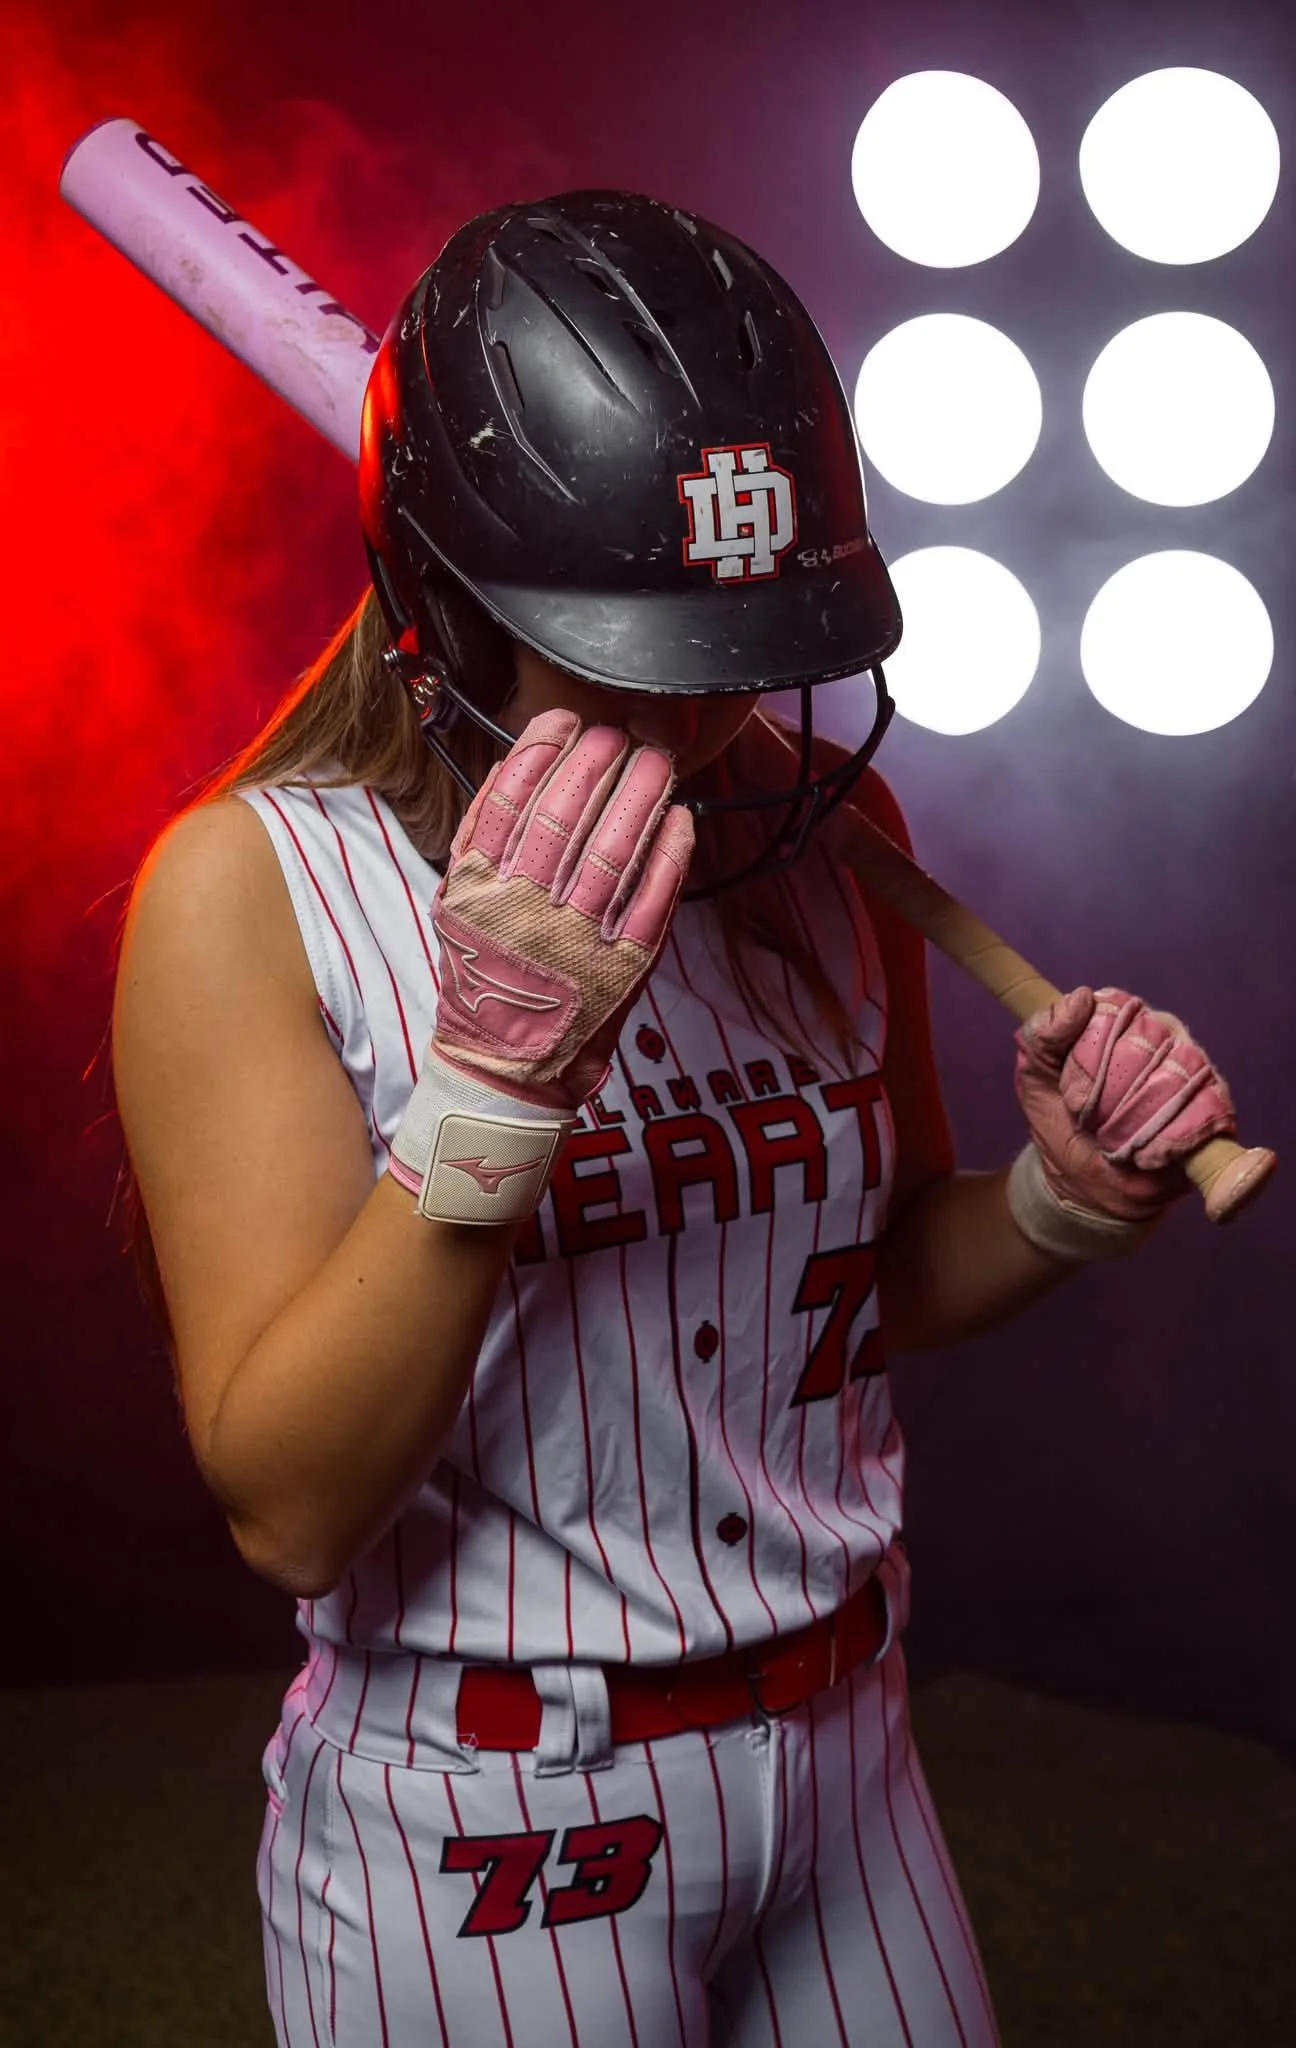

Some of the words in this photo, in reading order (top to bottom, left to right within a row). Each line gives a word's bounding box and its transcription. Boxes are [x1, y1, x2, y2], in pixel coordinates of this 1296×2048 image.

[571, 1054, 822, 1129] LAWARE
[789, 1239, 888, 1409] 7
[439, 1814, 663, 1938] 73
